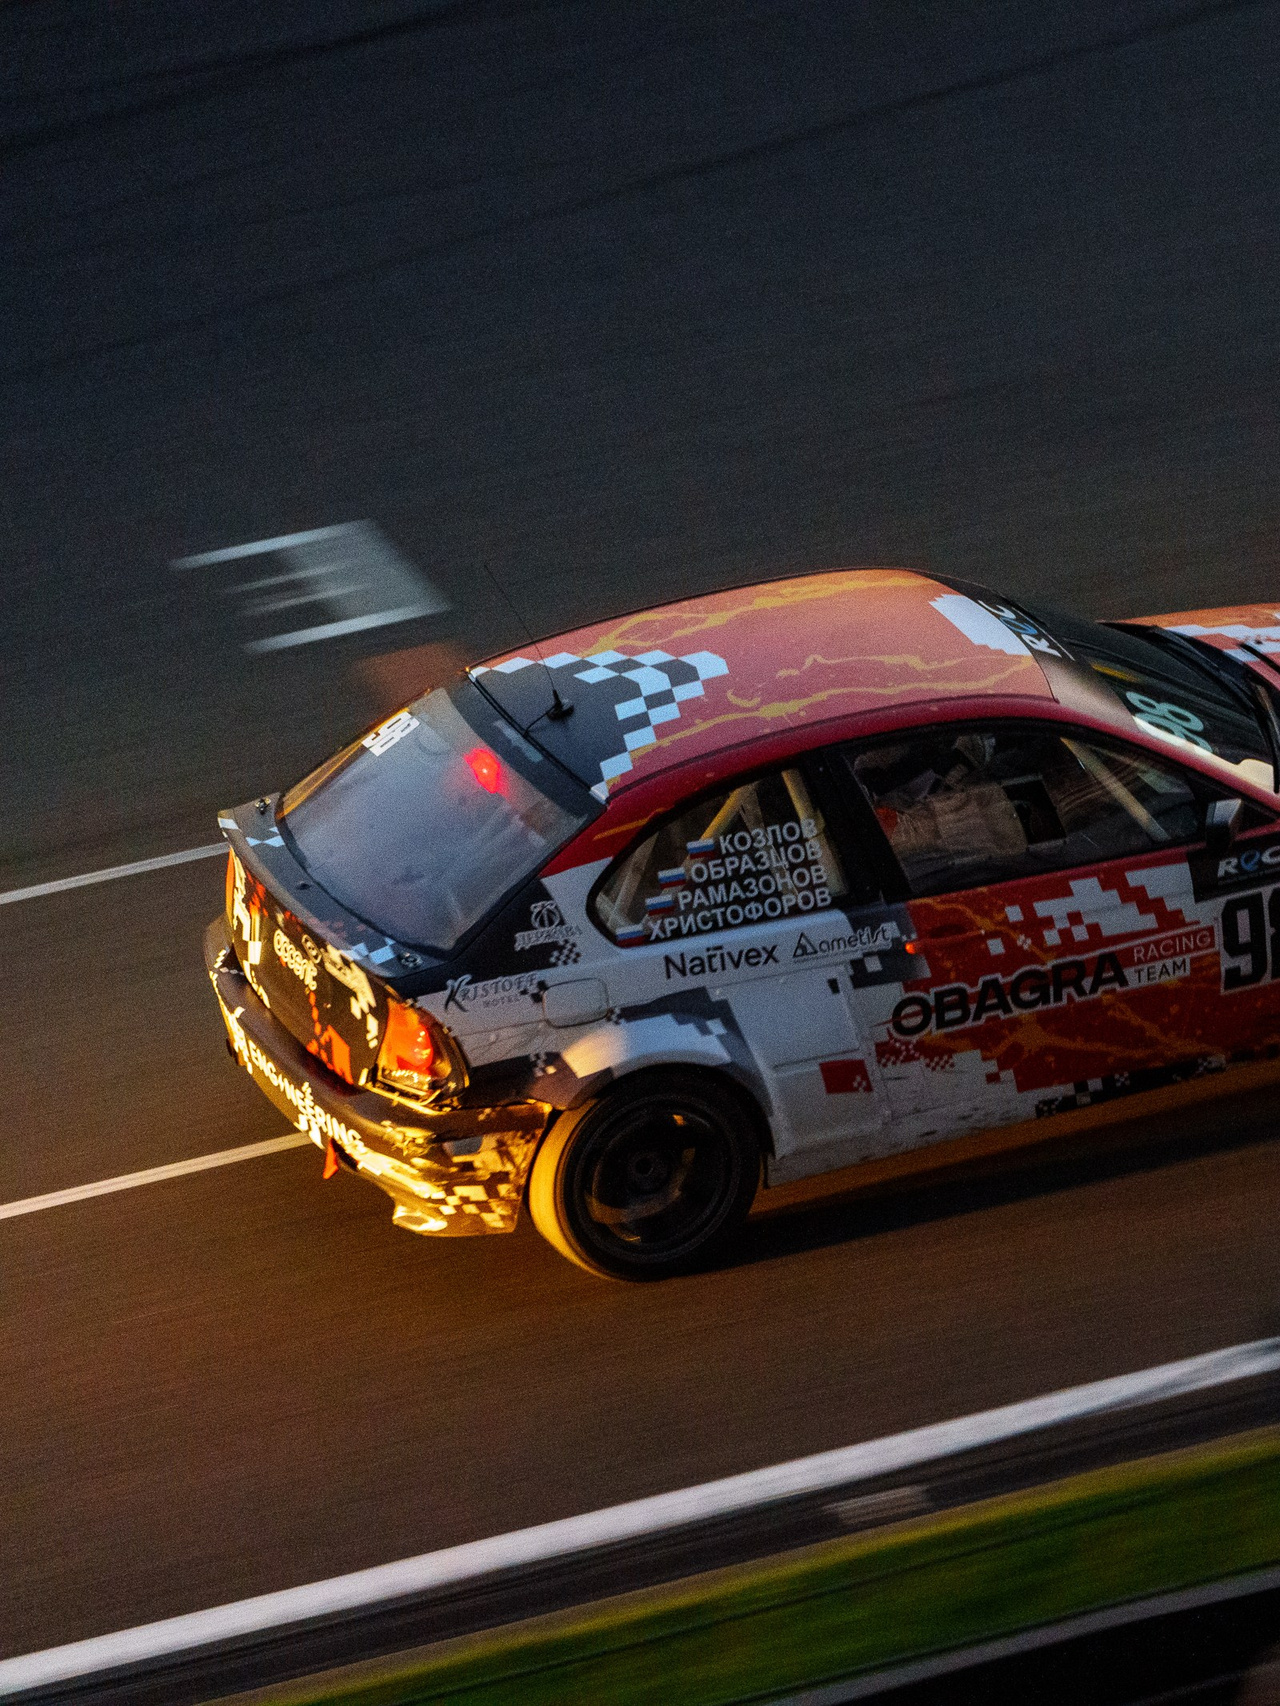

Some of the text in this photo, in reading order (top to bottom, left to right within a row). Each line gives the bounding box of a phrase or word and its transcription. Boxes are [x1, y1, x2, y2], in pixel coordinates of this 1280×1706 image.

[1126, 691, 1213, 754] 98
[719, 818, 818, 854] КОЗЛОВ
[690, 840, 823, 883] ОБРАЗЦОВ
[677, 865, 828, 911] РАМАЗОНОВ
[649, 887, 832, 941] ХРИСТОФОРОВ
[664, 943, 779, 979] Nativex
[1132, 930, 1212, 963] RACING
[1134, 957, 1190, 984] TEAM
[891, 953, 1129, 1037] OBAGRA
